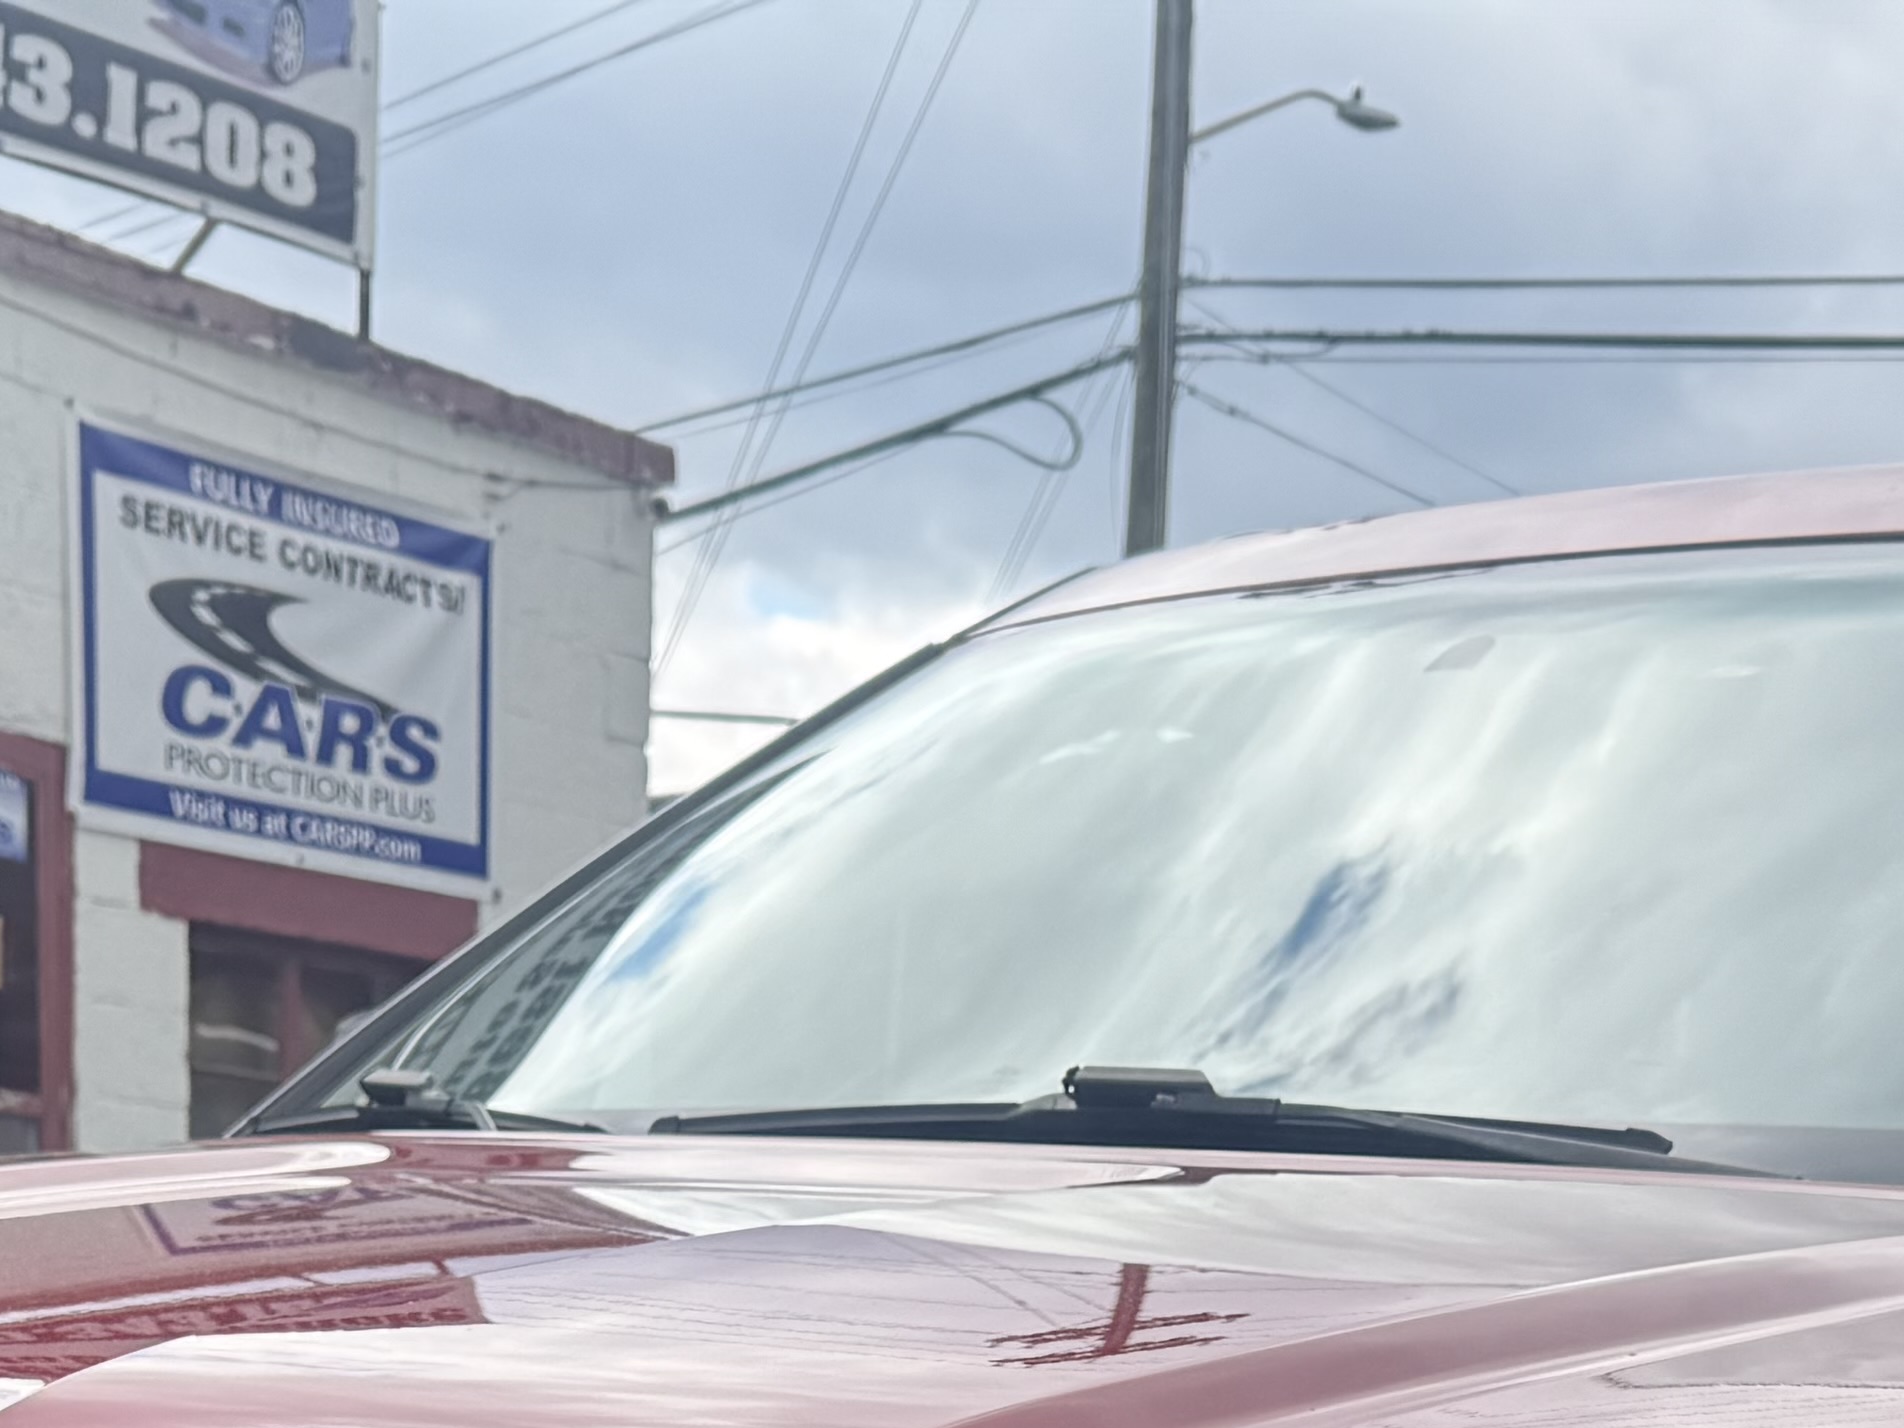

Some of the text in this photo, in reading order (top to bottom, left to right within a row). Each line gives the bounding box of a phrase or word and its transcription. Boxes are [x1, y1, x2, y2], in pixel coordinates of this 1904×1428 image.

[189, 463, 274, 515] FULLY
[119, 494, 268, 562] SERVICE
[164, 742, 436, 825] PROTECTION PLUS
[169, 786, 226, 827] Visit
[228, 806, 259, 834] us
[262, 811, 289, 839] at
